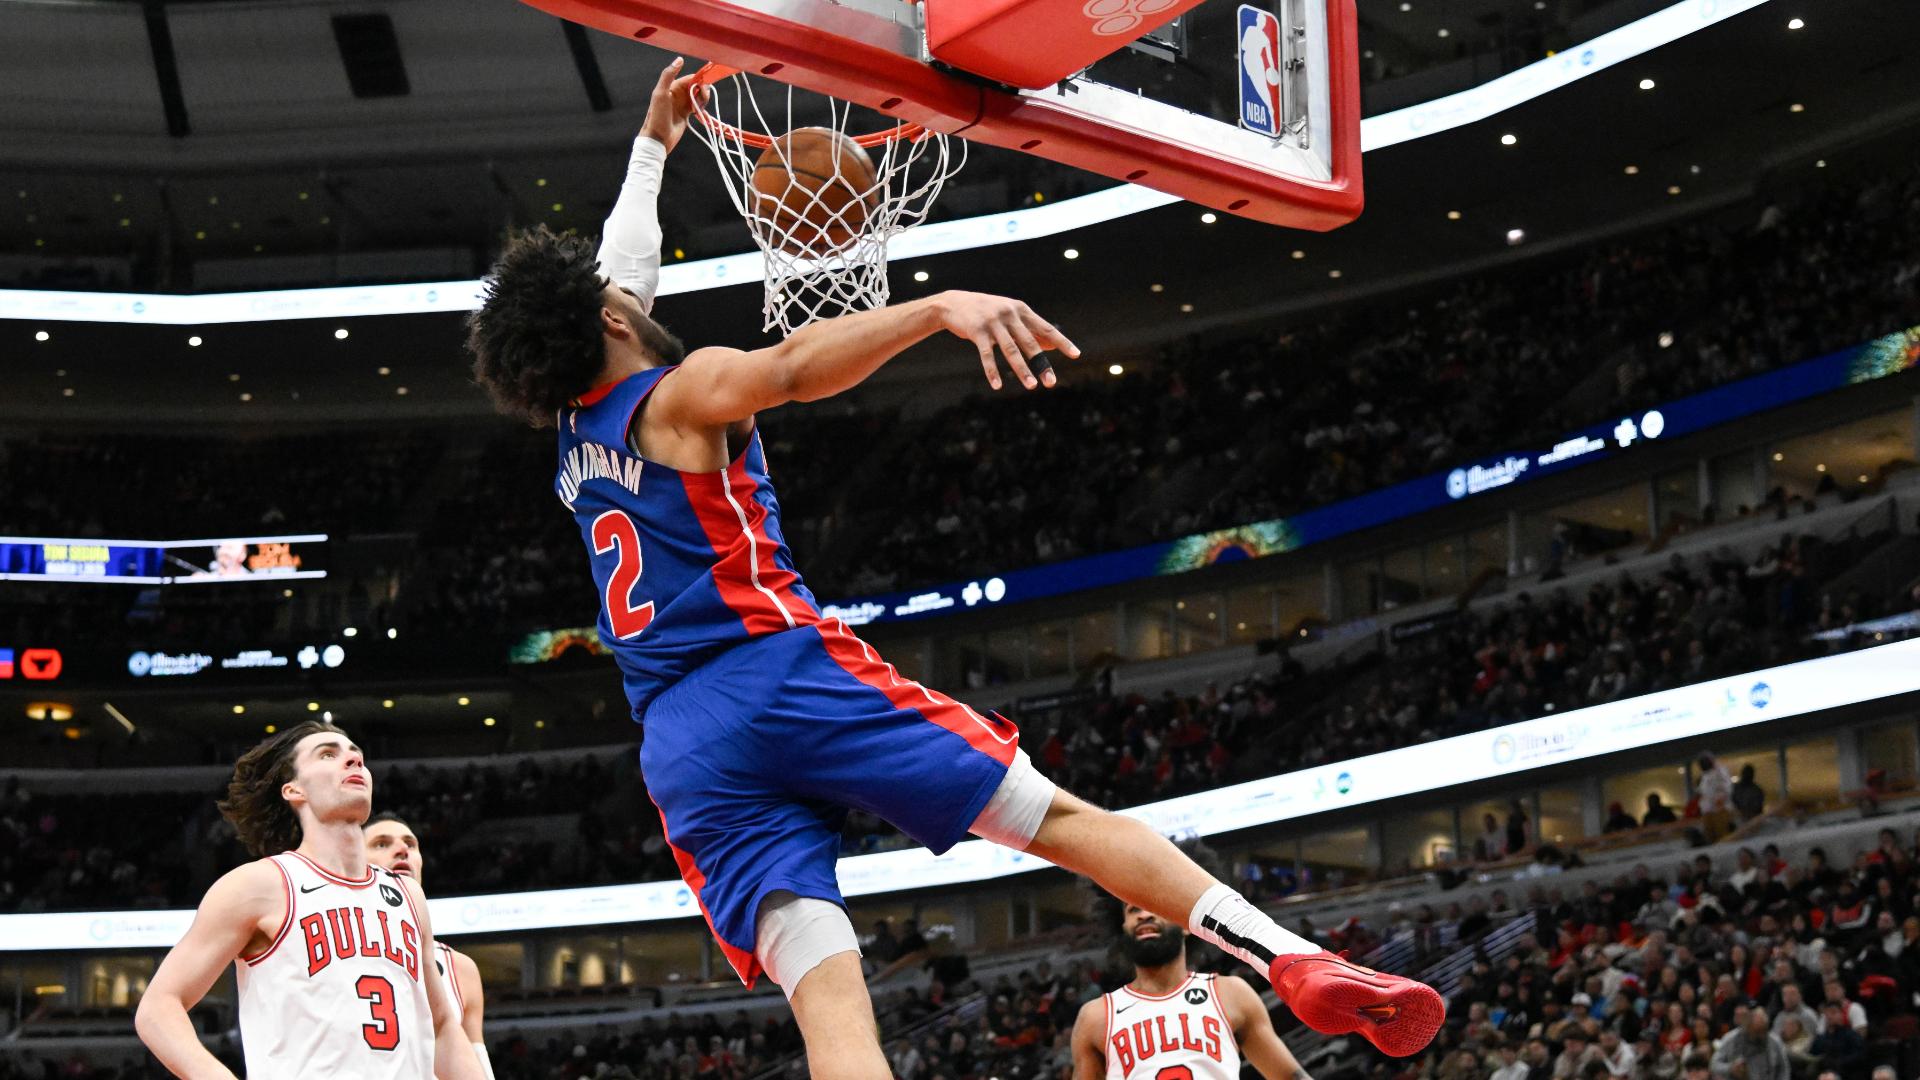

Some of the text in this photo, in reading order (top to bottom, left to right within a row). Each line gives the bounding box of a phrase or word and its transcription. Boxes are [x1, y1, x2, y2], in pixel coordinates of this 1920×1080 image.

[1246, 101, 1267, 126] NBA
[591, 509, 655, 641] 2
[300, 906, 419, 983] BULLS
[355, 974, 401, 1051] 3
[1111, 1013, 1222, 1080] BULLS
